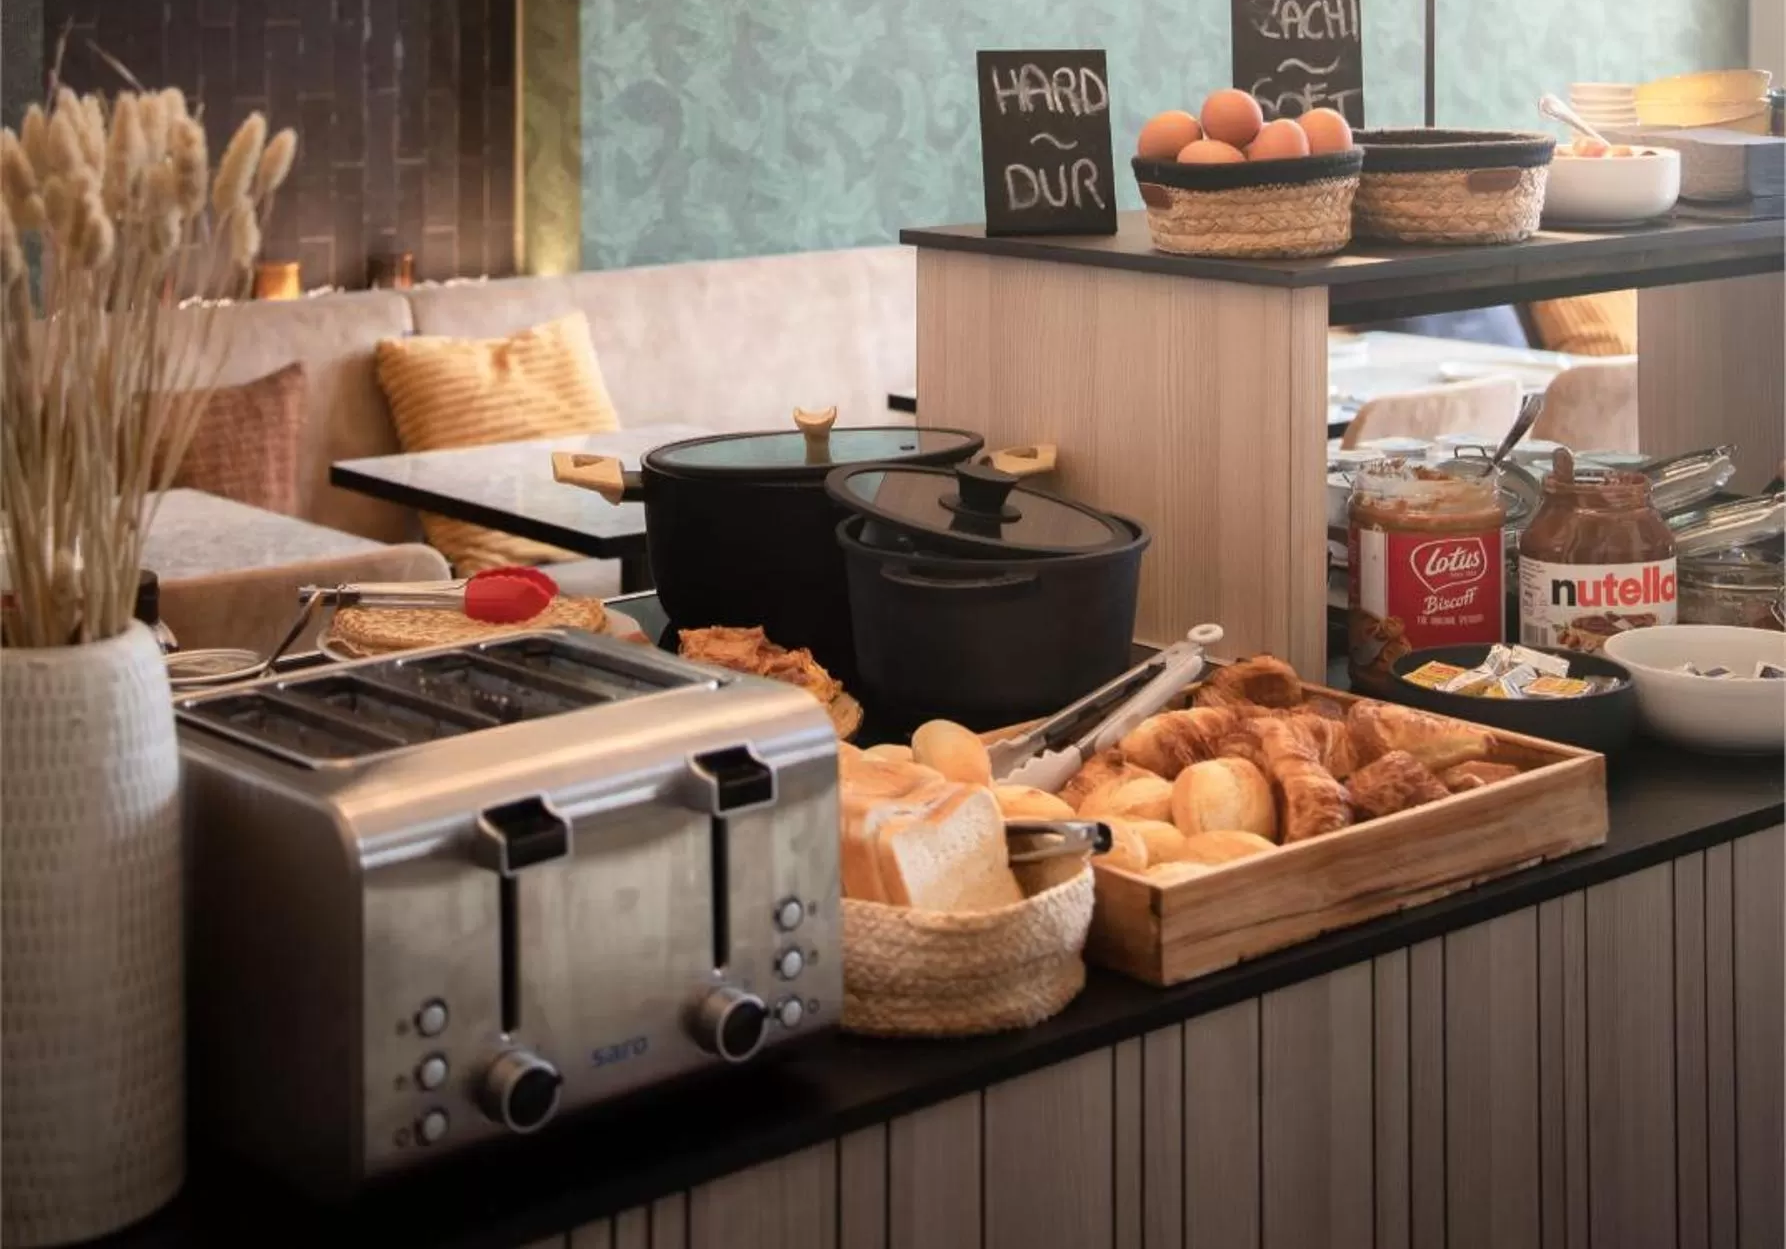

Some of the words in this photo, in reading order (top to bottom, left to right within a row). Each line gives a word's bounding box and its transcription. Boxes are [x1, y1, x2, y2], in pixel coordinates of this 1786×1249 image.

[992, 63, 1109, 116] HARD
[1005, 158, 1105, 210] DUR
[1424, 547, 1480, 576] Lotus
[1422, 586, 1479, 615] Biscoff
[1552, 566, 1676, 607] nutella
